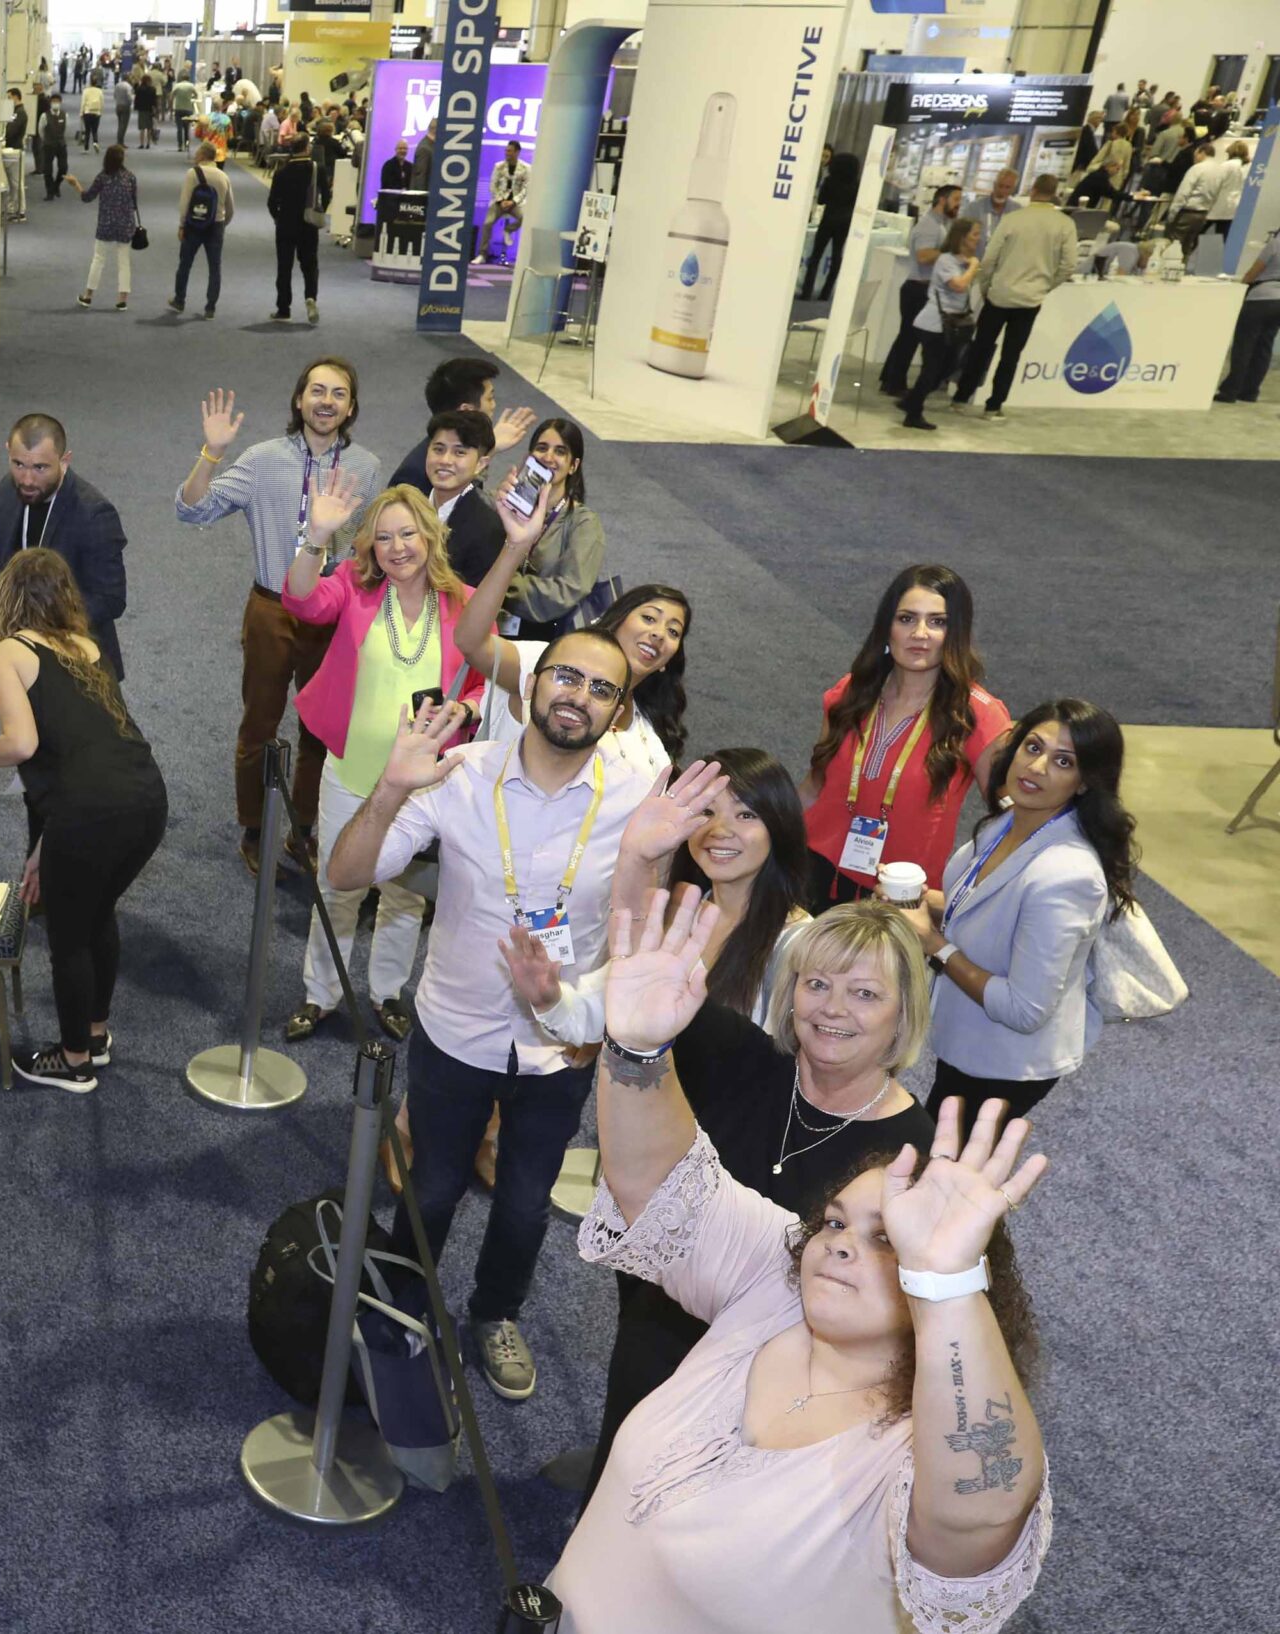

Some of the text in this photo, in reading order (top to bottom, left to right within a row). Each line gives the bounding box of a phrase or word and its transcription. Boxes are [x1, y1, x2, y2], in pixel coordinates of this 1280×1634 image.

[773, 26, 823, 200] EFFECTIVE
[910, 94, 989, 108] EYEDESIGNS
[429, 90, 478, 292] DIAMOND
[504, 849, 513, 876] Alcon
[569, 841, 585, 869] Alcon
